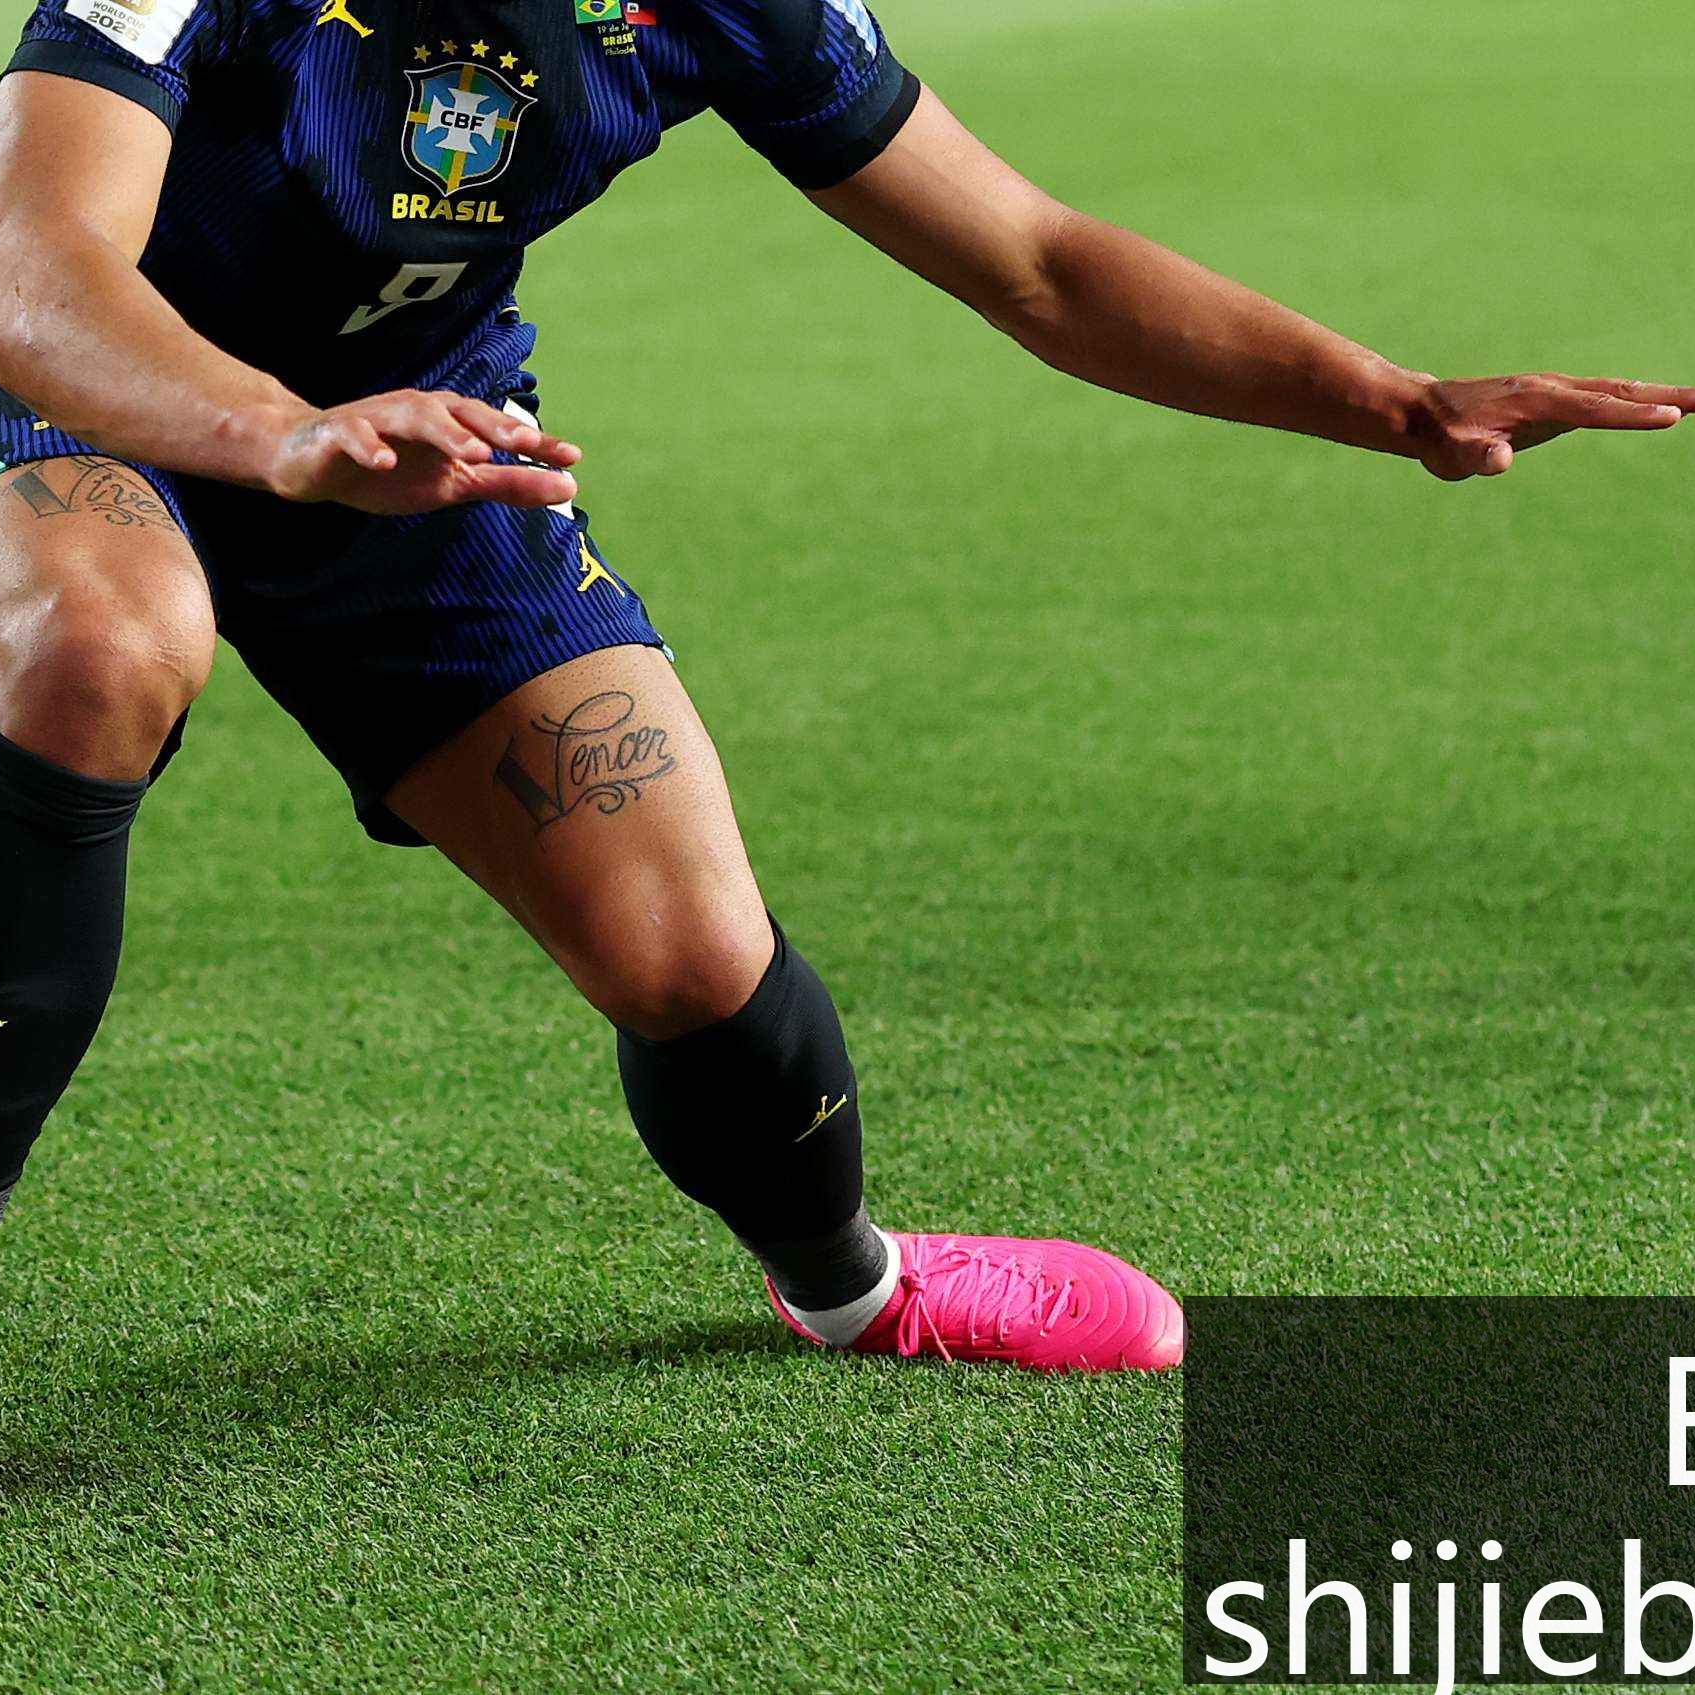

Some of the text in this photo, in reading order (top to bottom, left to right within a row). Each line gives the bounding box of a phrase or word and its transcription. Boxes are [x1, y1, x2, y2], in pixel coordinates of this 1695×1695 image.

[93, 0, 126, 20] WORLD
[440, 110, 485, 131] CBF
[392, 193, 505, 223] BRASIL
